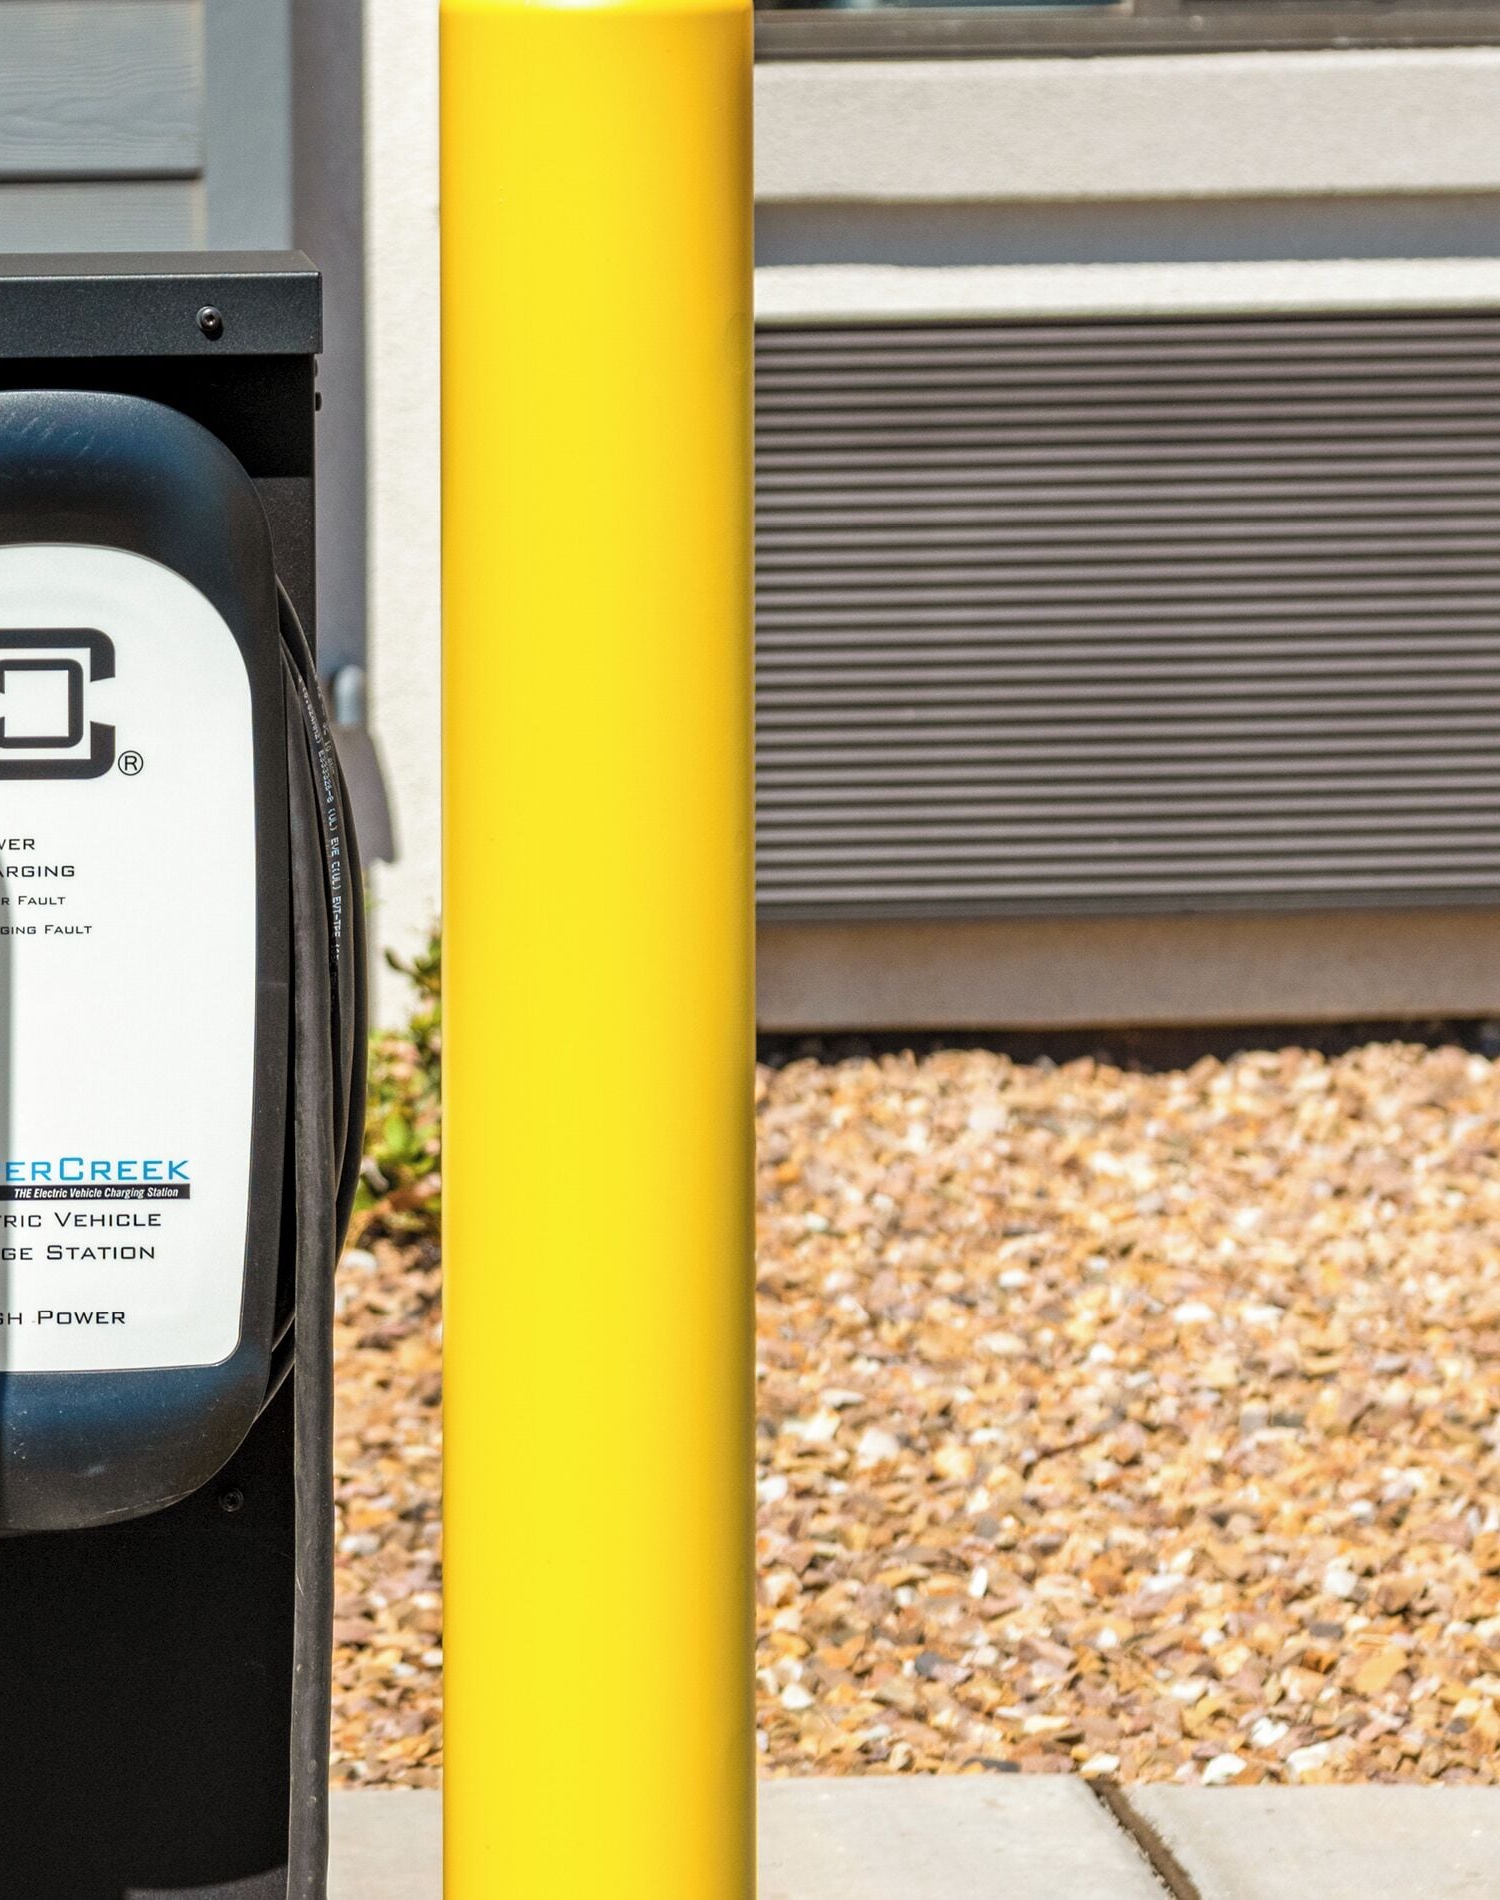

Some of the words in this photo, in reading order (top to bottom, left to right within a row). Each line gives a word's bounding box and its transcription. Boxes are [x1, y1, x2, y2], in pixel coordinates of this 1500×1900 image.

[327, 808, 339, 831] (UL)
[330, 836, 341, 856] EVE
[331, 861, 342, 890] C(UL)
[18, 896, 66, 906] FAULT
[331, 895, 343, 938] EVT-TPE
[45, 925, 93, 935] FAULT
[14, 1188, 32, 1198] THE
[33, 1188, 67, 1198] Electric
[70, 1188, 102, 1198] Vehicle
[104, 1187, 145, 1199] Charging
[147, 1187, 179, 1198] Station
[54, 1212, 162, 1228] VEHICLE
[47, 1245, 155, 1260] STATION
[38, 1310, 126, 1325] POWER
